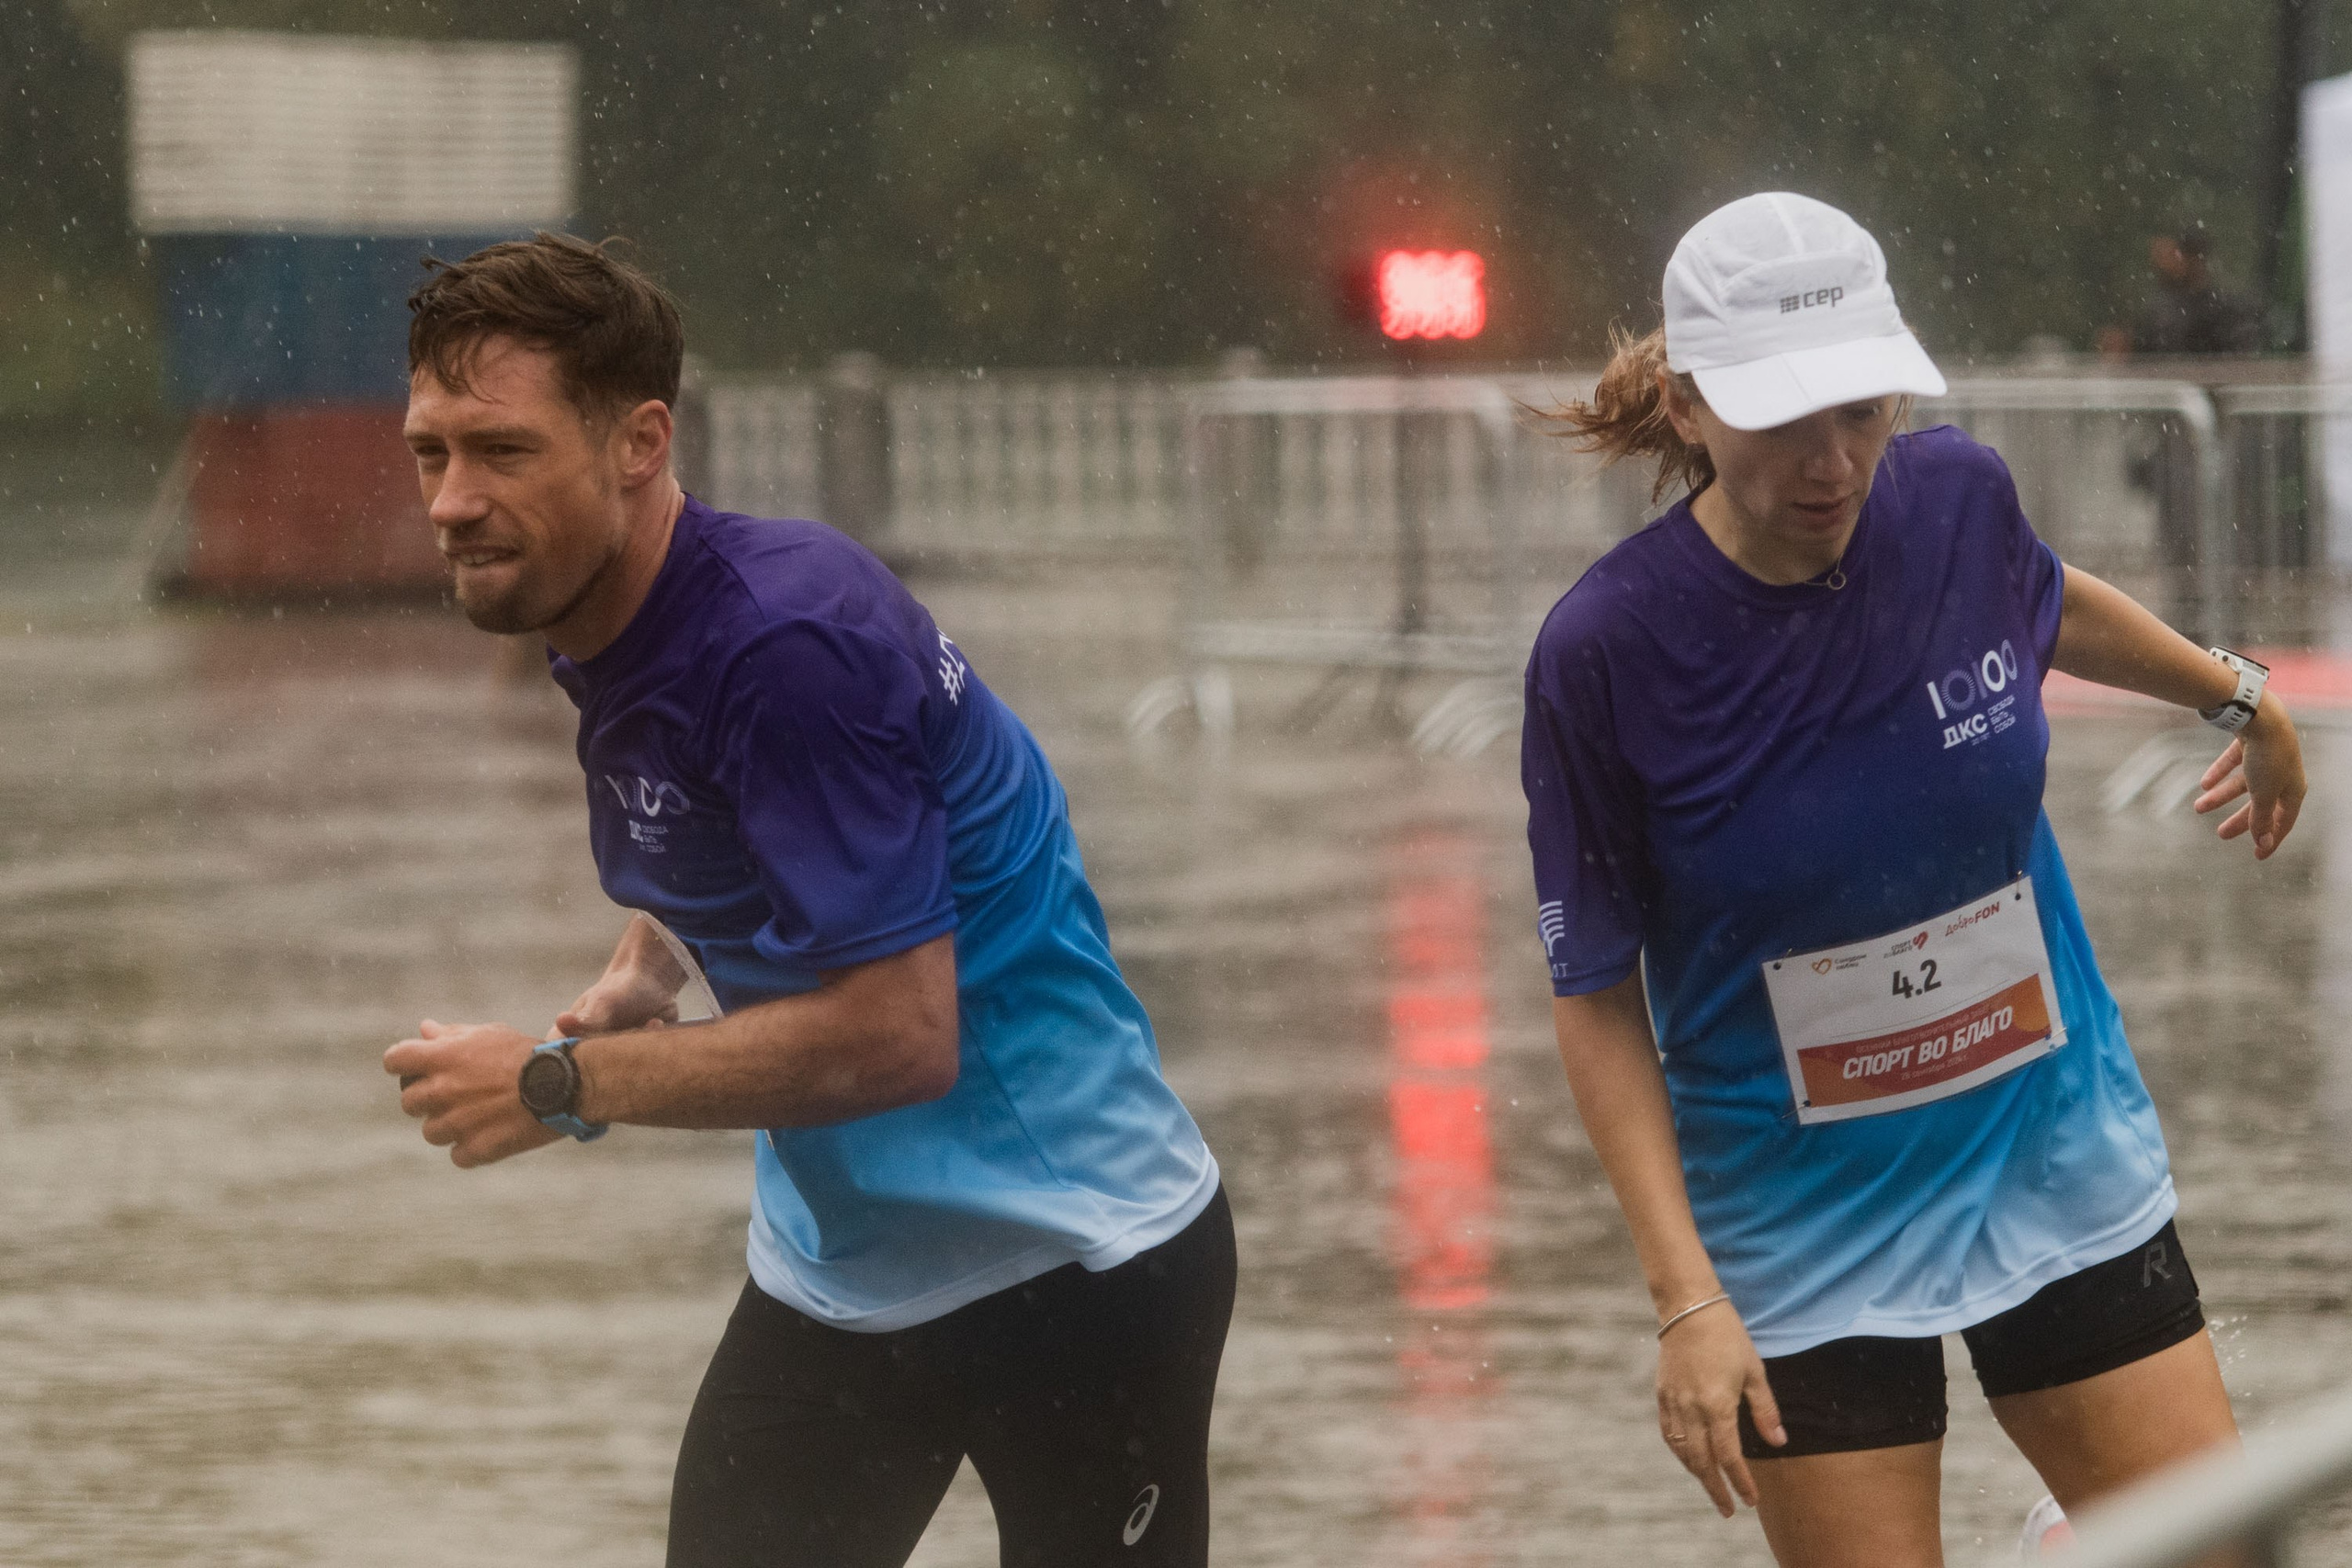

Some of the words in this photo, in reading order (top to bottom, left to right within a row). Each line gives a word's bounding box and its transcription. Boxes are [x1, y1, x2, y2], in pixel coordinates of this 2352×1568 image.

[1803, 286, 1844, 308] cep
[1943, 713, 1988, 750] ДКС
[1892, 959, 1942, 999] 4.2
[1842, 1045, 1915, 1079] СПОРТ
[1917, 1035, 1948, 1065] ВО
[1951, 1005, 2013, 1054] БЛАГО
